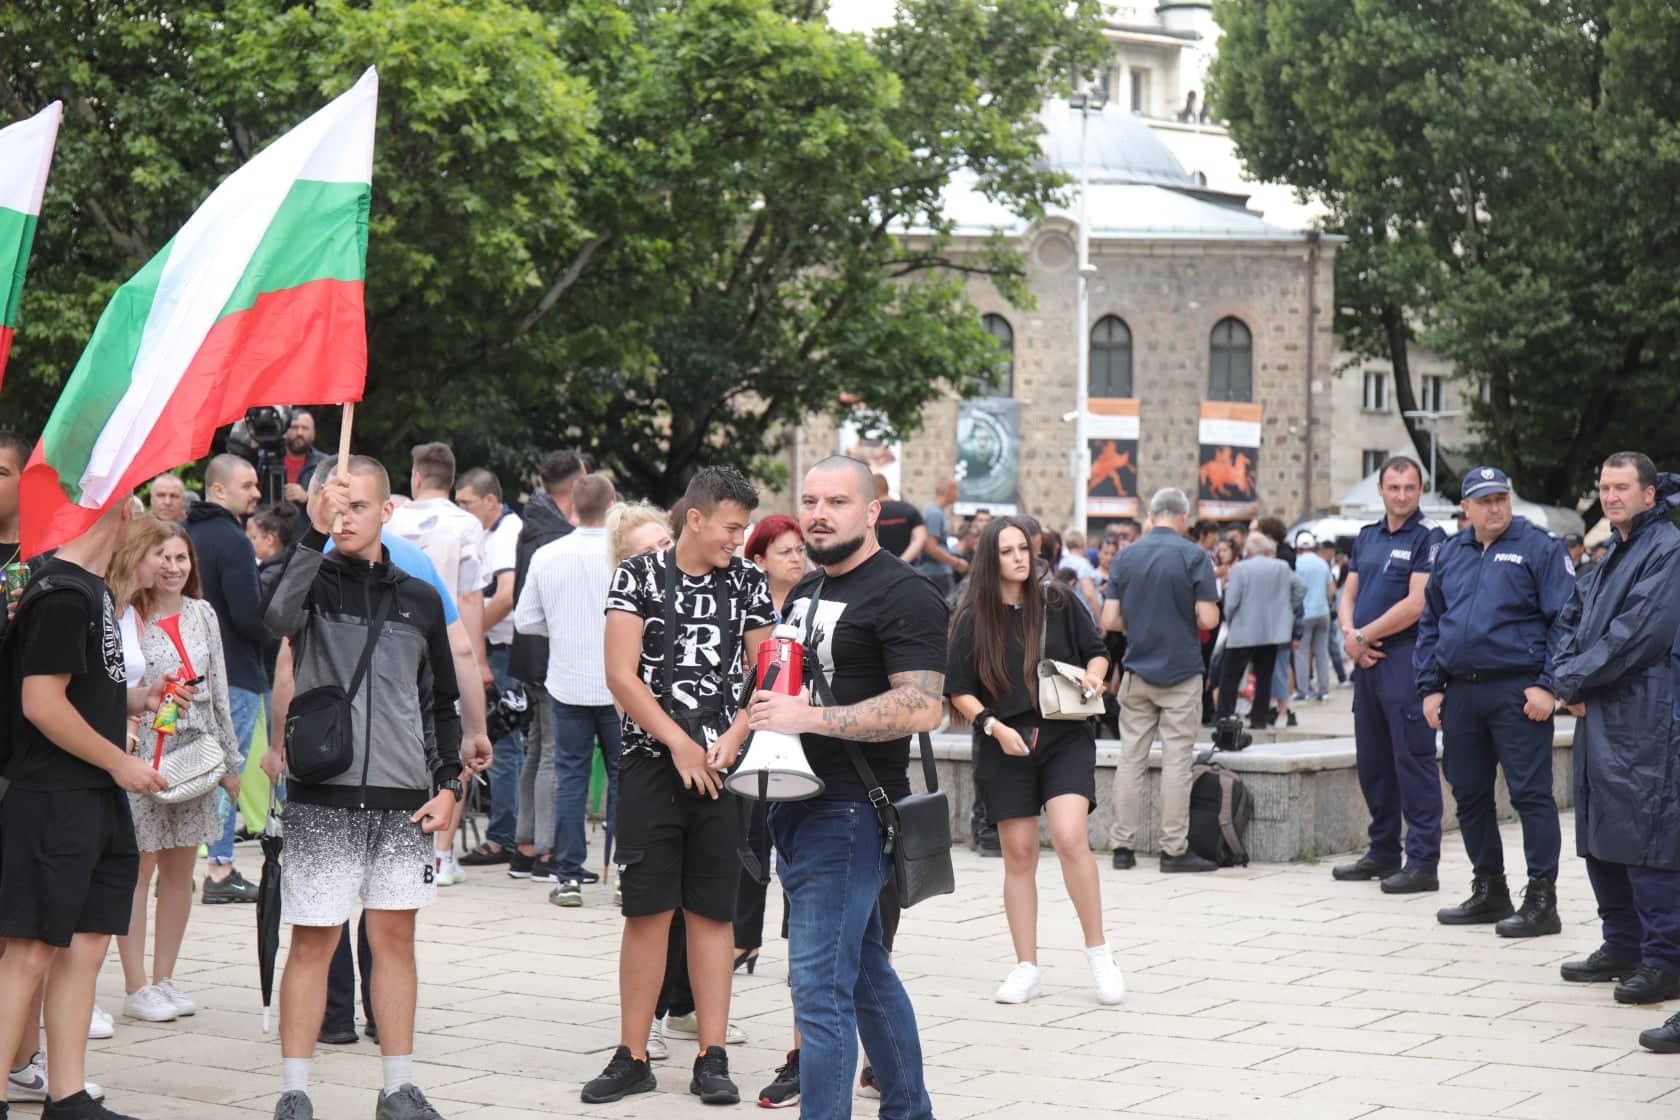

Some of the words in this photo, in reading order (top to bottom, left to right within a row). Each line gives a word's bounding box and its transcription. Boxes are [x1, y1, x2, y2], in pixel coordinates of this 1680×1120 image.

[609, 567, 637, 593] D
[691, 593, 717, 618] D
[676, 623, 721, 667] R
[423, 864, 434, 884] B
